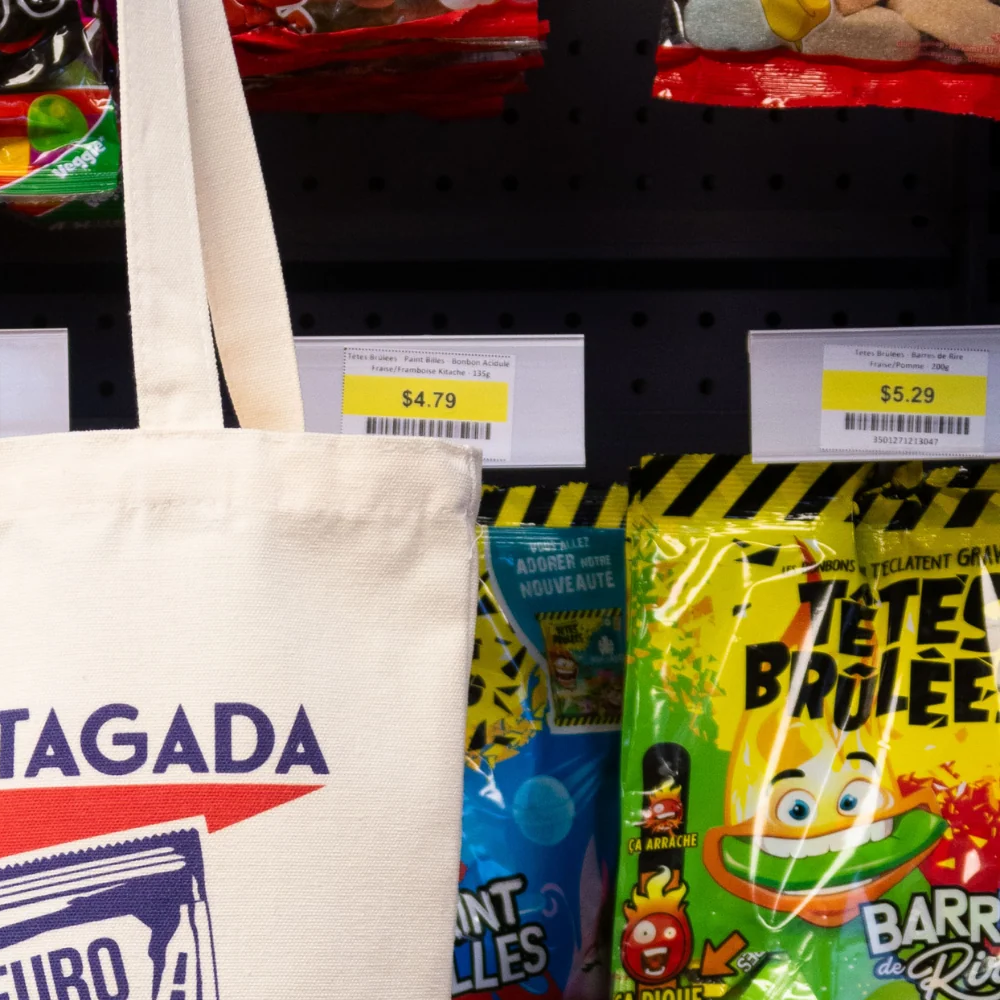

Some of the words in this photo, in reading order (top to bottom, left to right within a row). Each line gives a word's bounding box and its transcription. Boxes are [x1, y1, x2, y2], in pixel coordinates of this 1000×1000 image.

[404, 355, 423, 364] Paint
[425, 356, 445, 365] Billes
[452, 357, 480, 367] Bonbon
[911, 351, 936, 360] Barres
[937, 351, 947, 360] de
[949, 352, 964, 361] Rire
[371, 365, 437, 376] Fraise/Framboise
[438, 368, 466, 377] Kitache
[472, 369, 491, 378] 135g
[870, 360, 924, 370] Fraise/Pomme
[931, 363, 950, 372] 200g
[402, 389, 457, 409] $4.79
[880, 384, 935, 404] $5.29
[873, 435, 939, 446] 3501271213047
[559, 536, 590, 550] ALLEZ
[516, 553, 576, 575] ADORER
[580, 554, 612, 569] NOTRE
[745, 641, 1000, 732] BRÛLÉE
[628, 836, 643, 853] ÇA
[646, 833, 698, 850] ARRACHE
[876, 956, 906, 975] de
